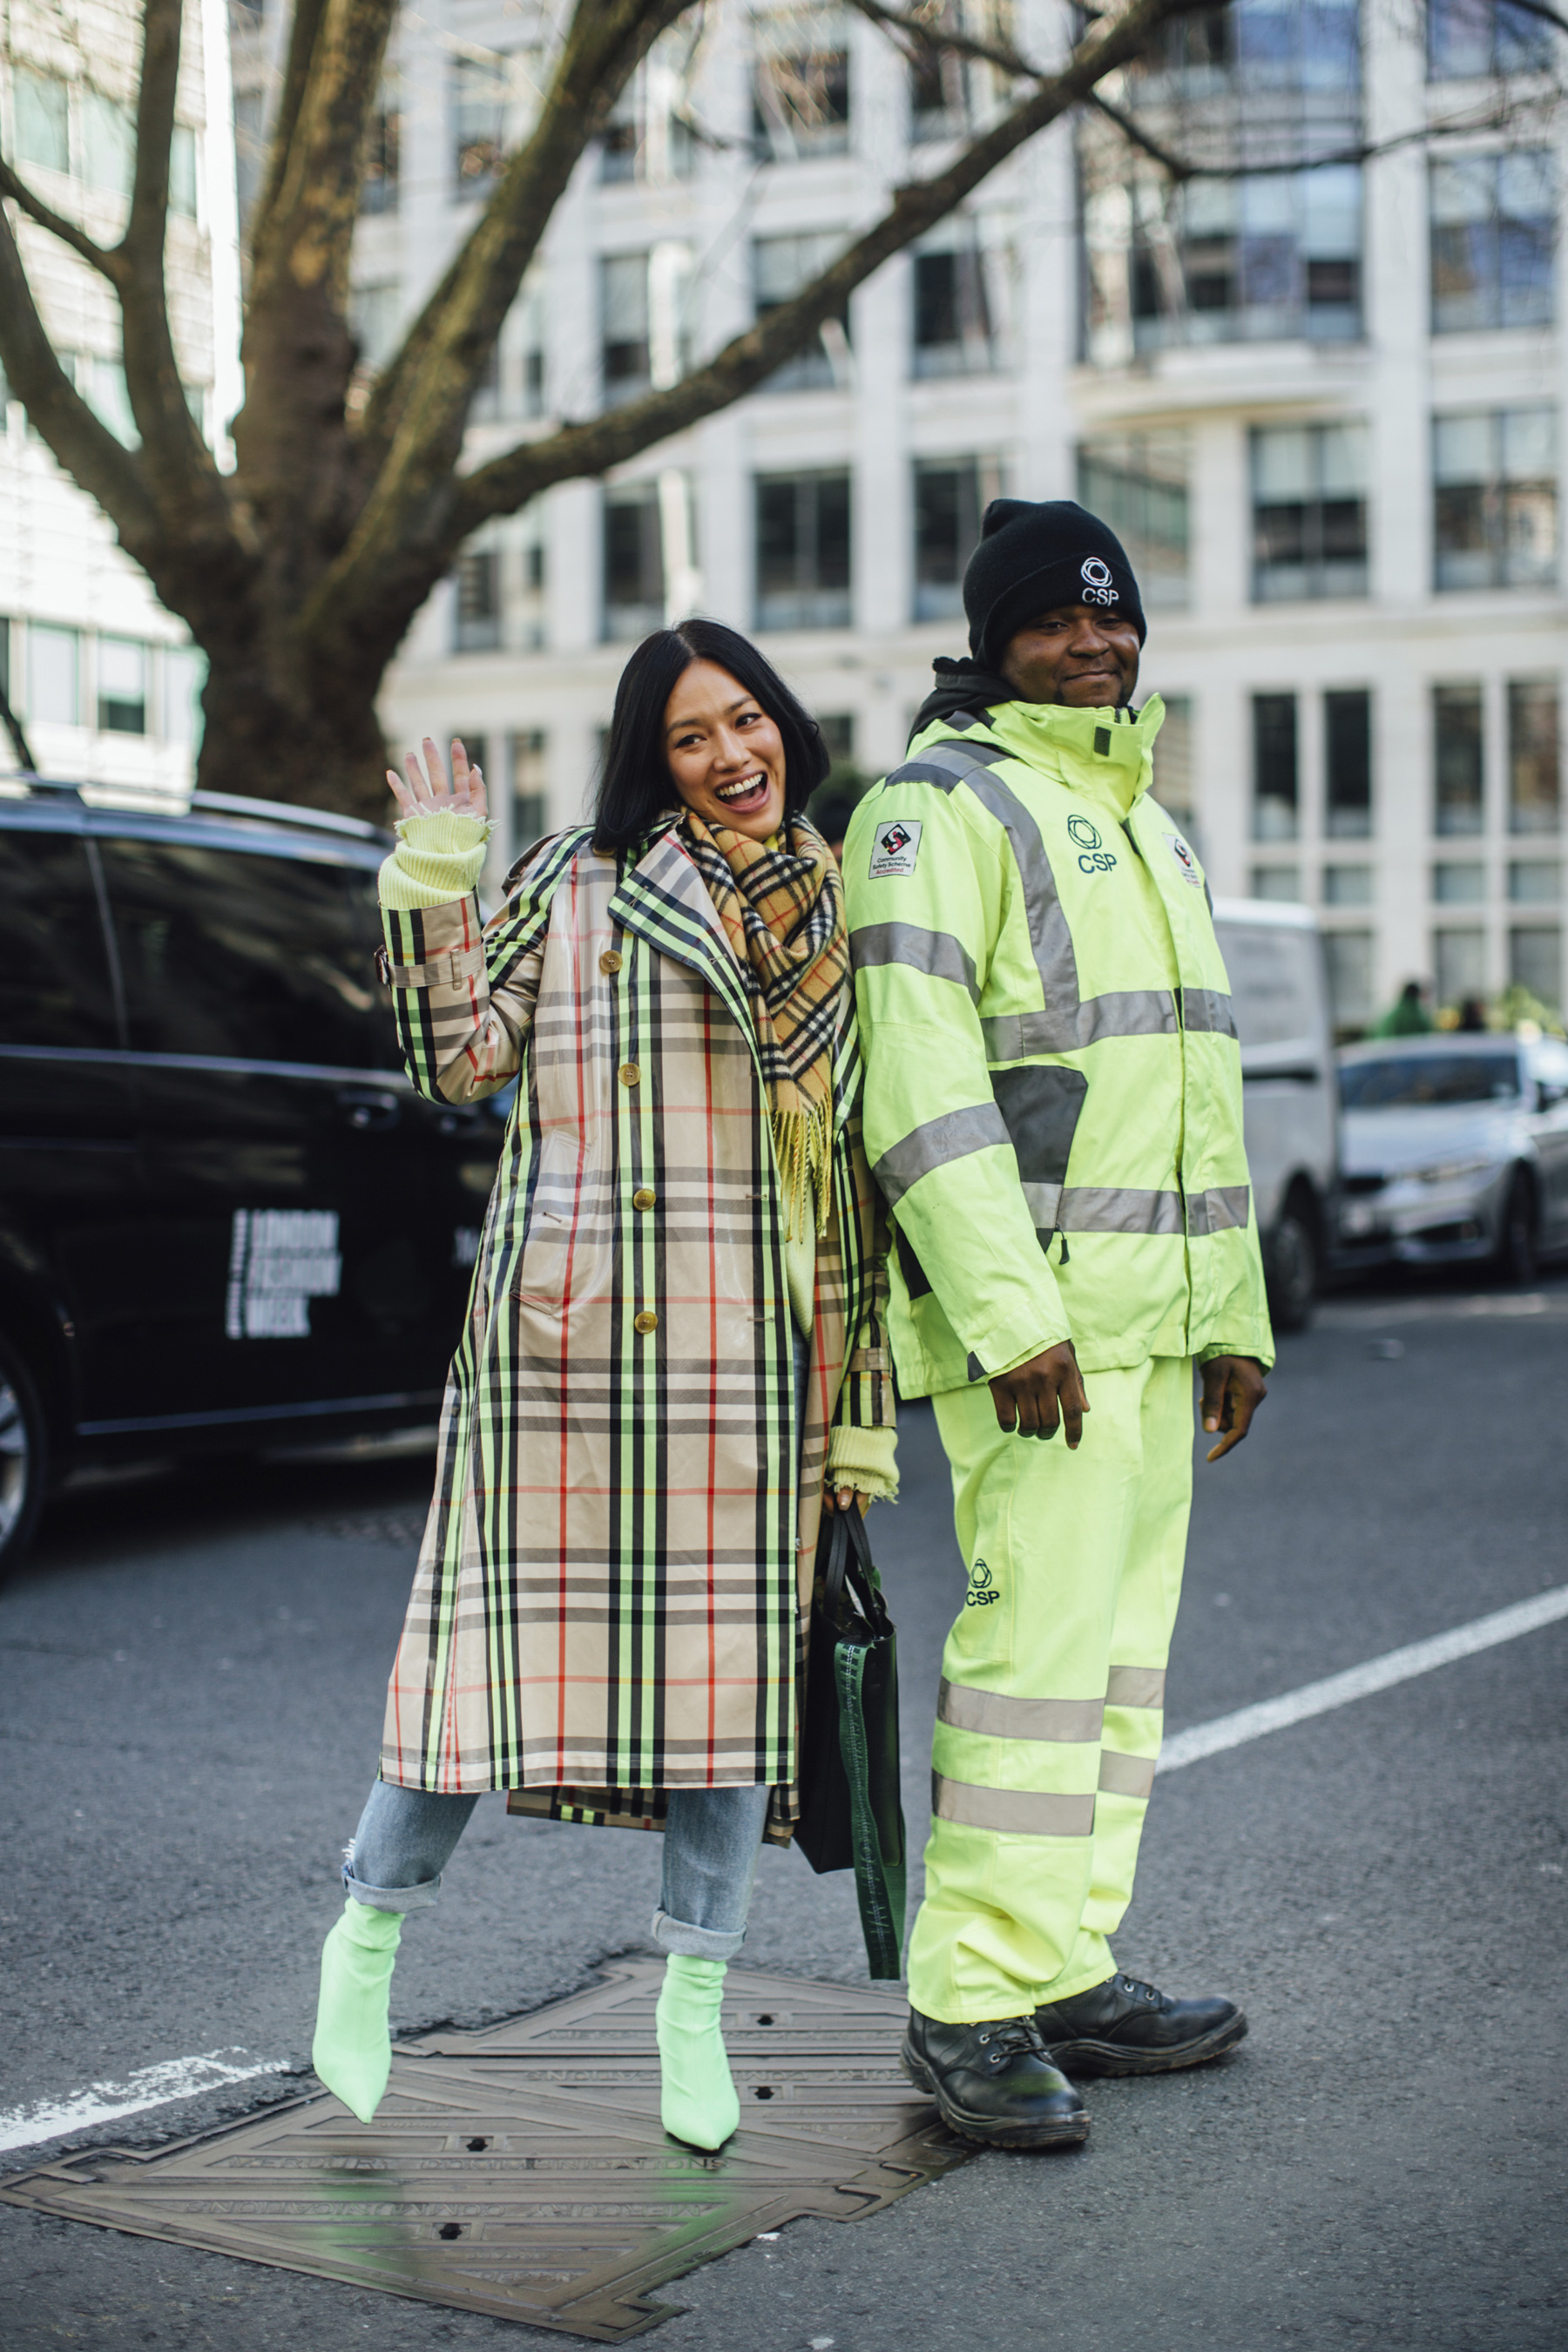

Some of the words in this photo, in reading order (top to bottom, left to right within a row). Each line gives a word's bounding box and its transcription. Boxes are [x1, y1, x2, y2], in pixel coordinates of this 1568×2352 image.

[1082, 587, 1119, 606] CSP
[1078, 853, 1117, 874] CSP
[966, 1591, 1000, 1606] CSP
